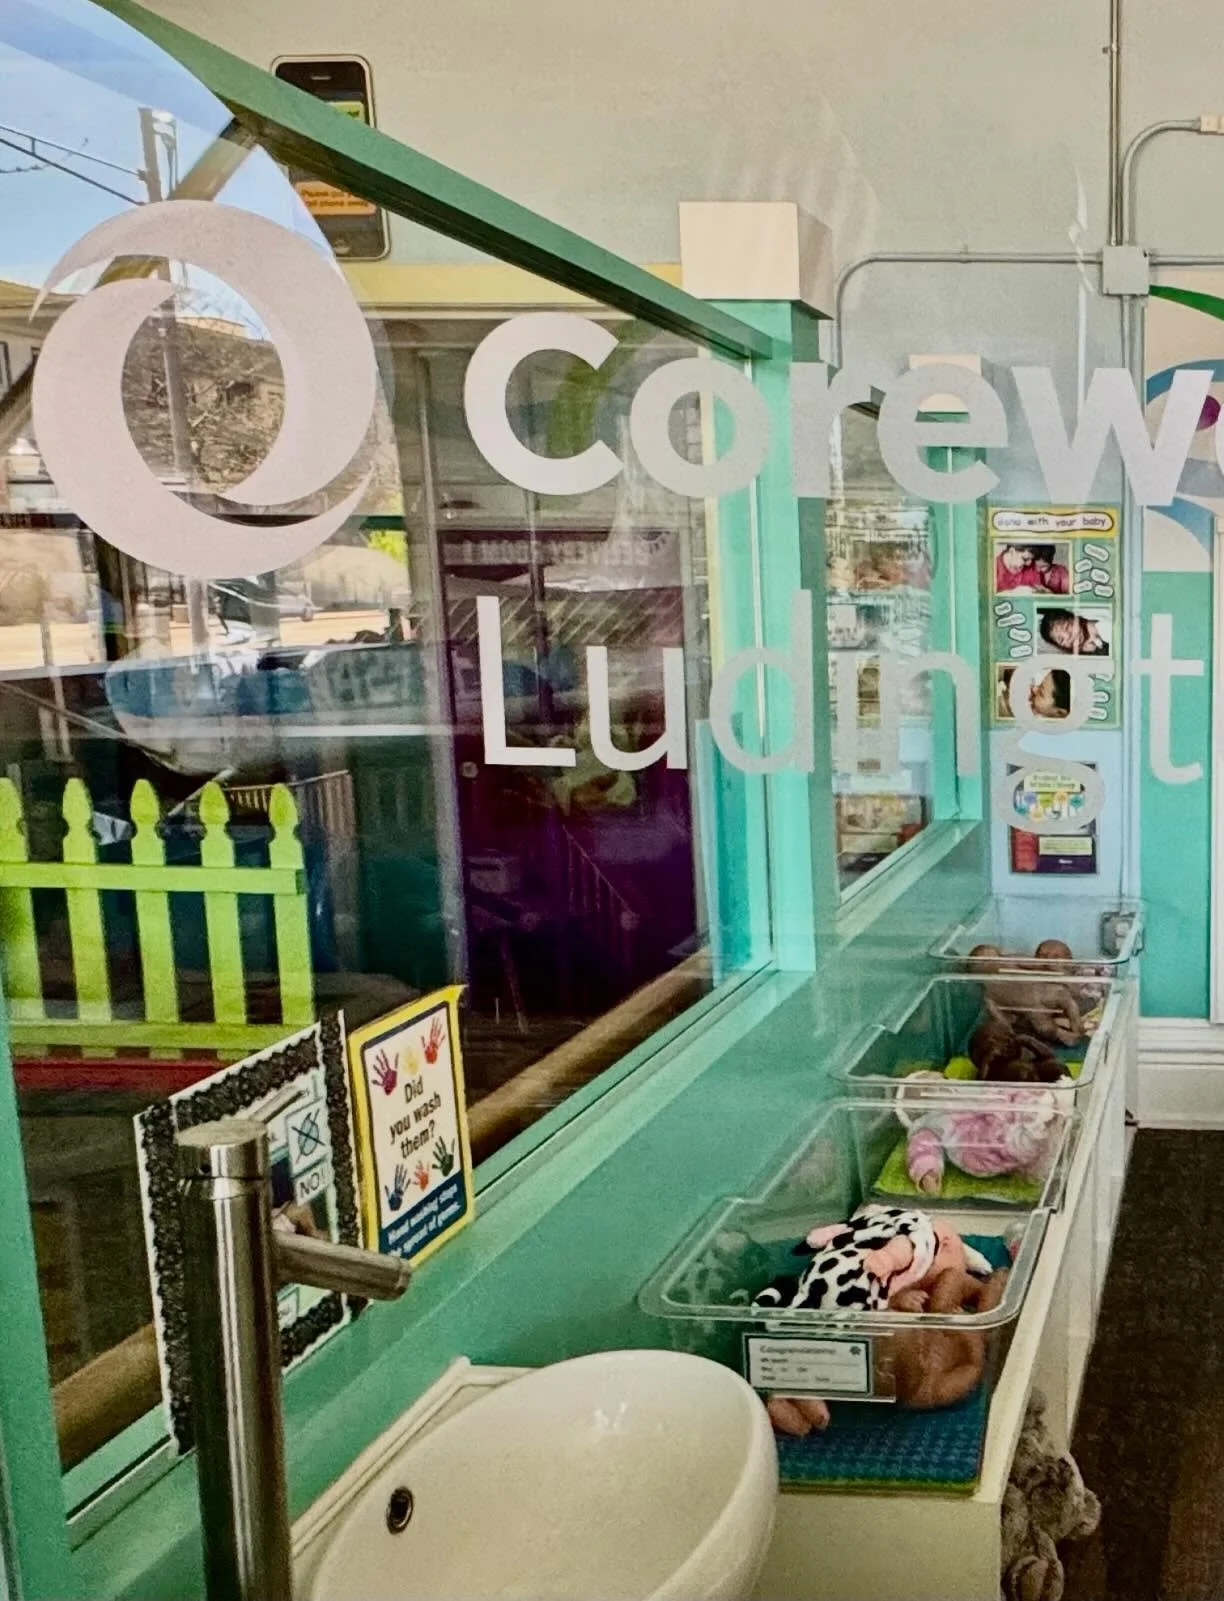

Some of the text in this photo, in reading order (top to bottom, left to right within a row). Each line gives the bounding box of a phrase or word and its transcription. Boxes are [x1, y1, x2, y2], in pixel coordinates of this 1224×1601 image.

[1082, 516, 1107, 529] baby
[404, 1075, 425, 1104] Did
[389, 1091, 442, 1145] you wash
[399, 1119, 436, 1160] them?
